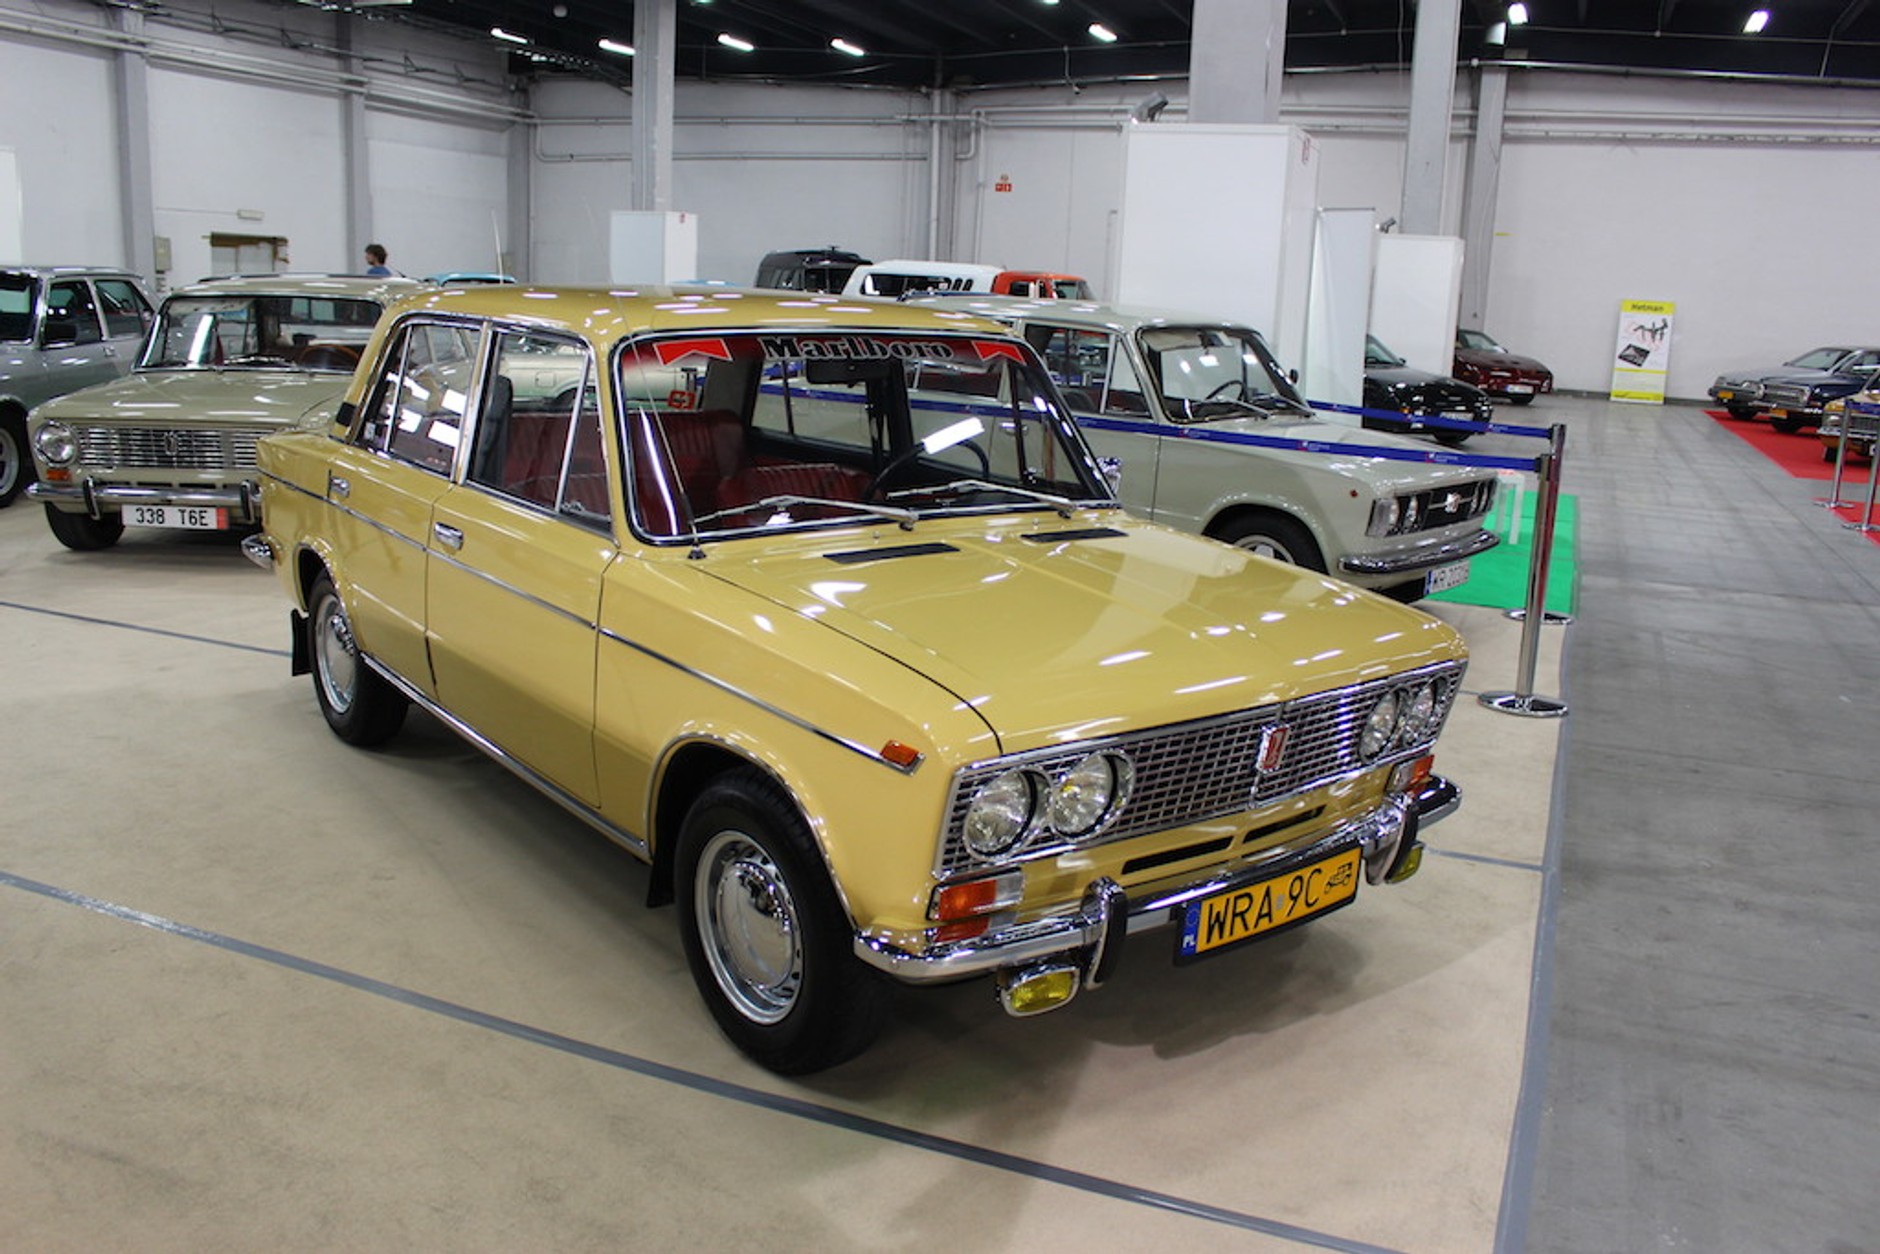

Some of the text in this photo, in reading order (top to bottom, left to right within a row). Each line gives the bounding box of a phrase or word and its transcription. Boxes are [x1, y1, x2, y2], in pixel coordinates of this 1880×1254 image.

[757, 336, 954, 360] Marlboro
[135, 507, 208, 527] 338 T6E
[1206, 867, 1322, 944] WRA 9C
[1182, 934, 1196, 949] PL
